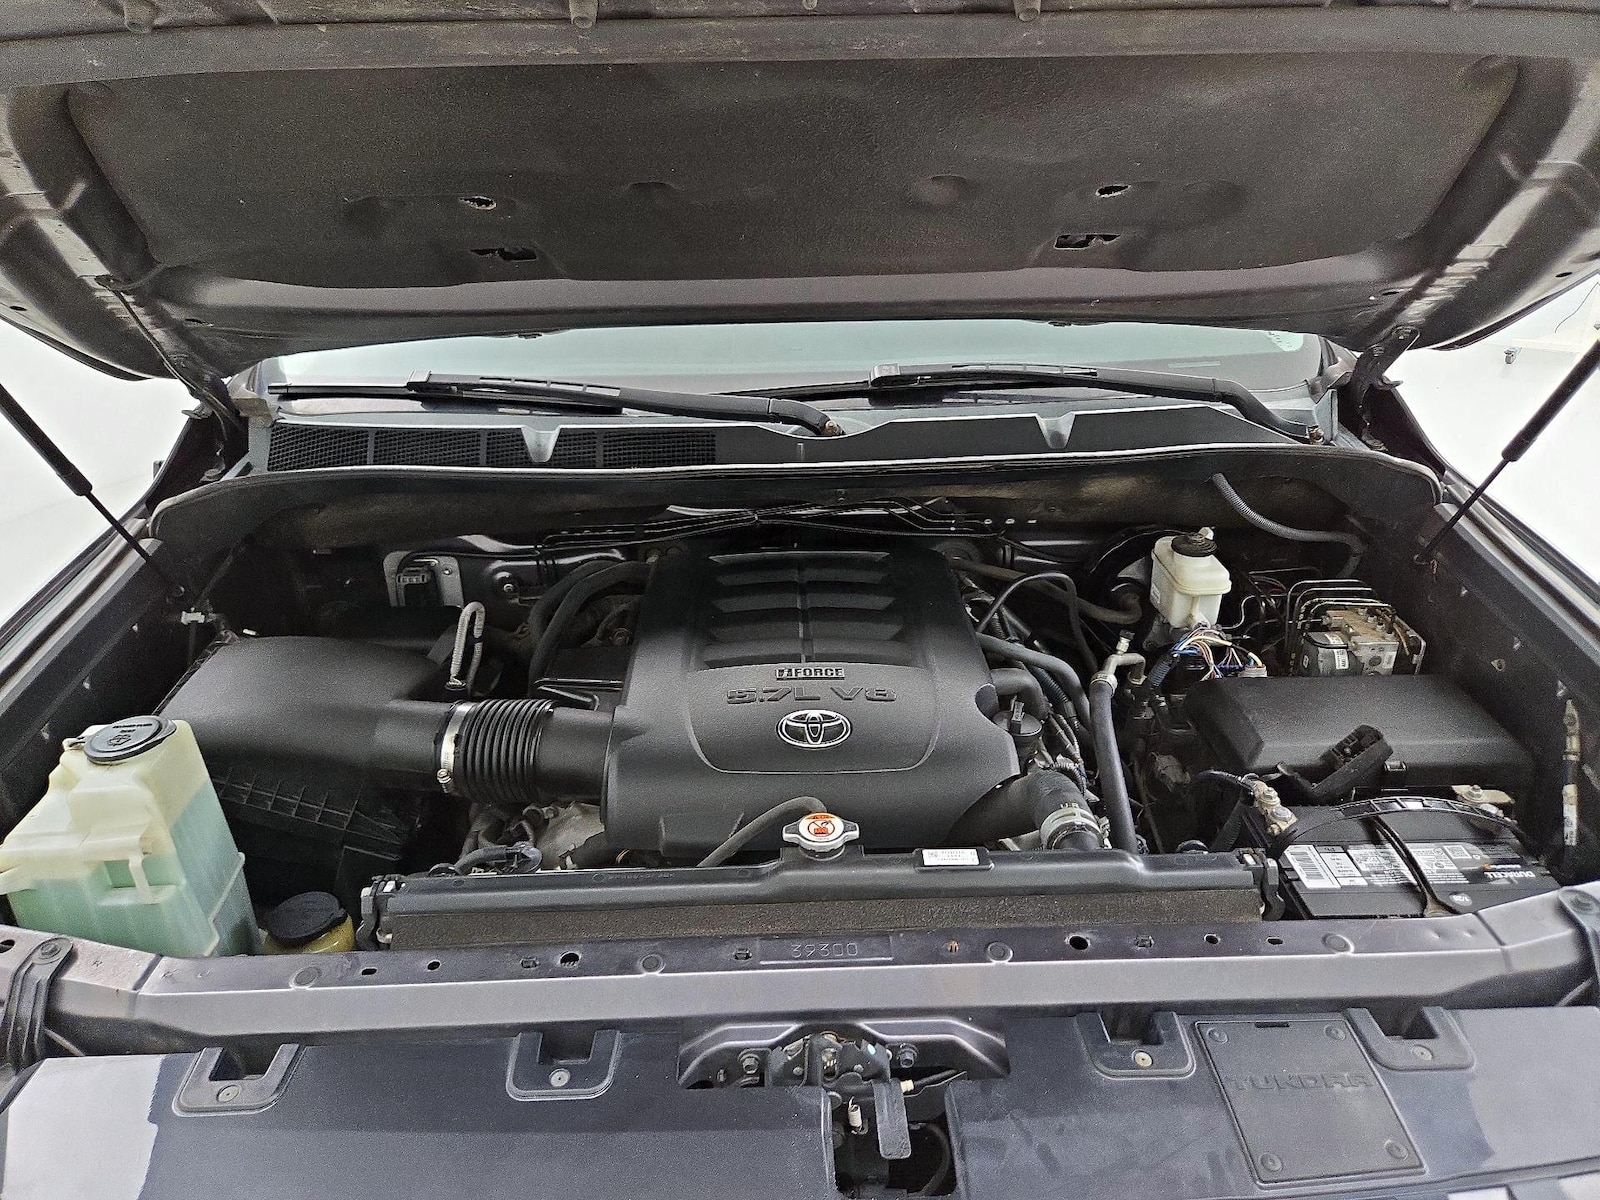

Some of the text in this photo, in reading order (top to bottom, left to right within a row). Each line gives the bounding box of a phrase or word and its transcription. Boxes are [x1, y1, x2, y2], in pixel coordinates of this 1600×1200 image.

[727, 686, 897, 704] 5.7L V8
[1483, 870, 1537, 879] DURACELL
[791, 942, 859, 958] 39300
